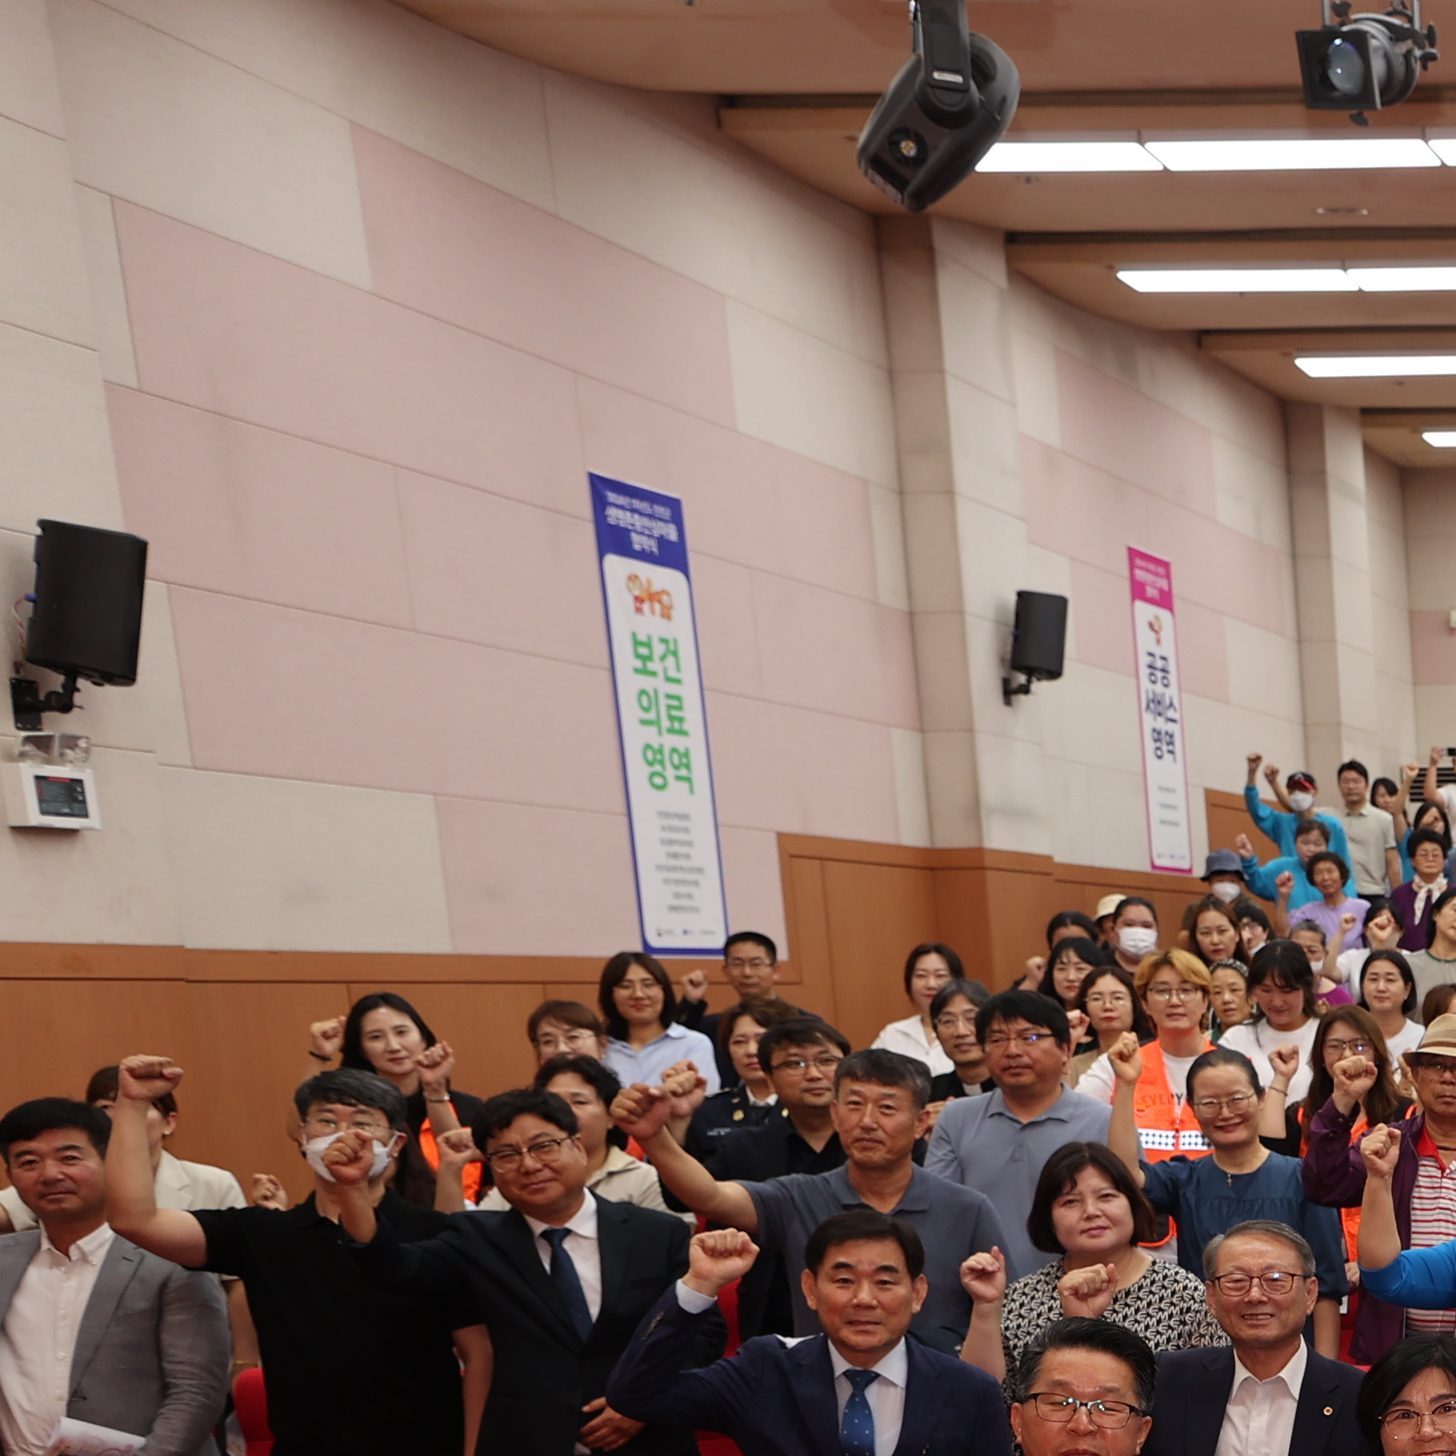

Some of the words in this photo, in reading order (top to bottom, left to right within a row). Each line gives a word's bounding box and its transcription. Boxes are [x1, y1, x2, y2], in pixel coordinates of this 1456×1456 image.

[631, 630, 684, 685] 보건
[1146, 650, 1171, 689] 공공
[637, 687, 690, 739] 의료
[642, 742, 695, 795] 영역
[1151, 726, 1177, 763] 영역
